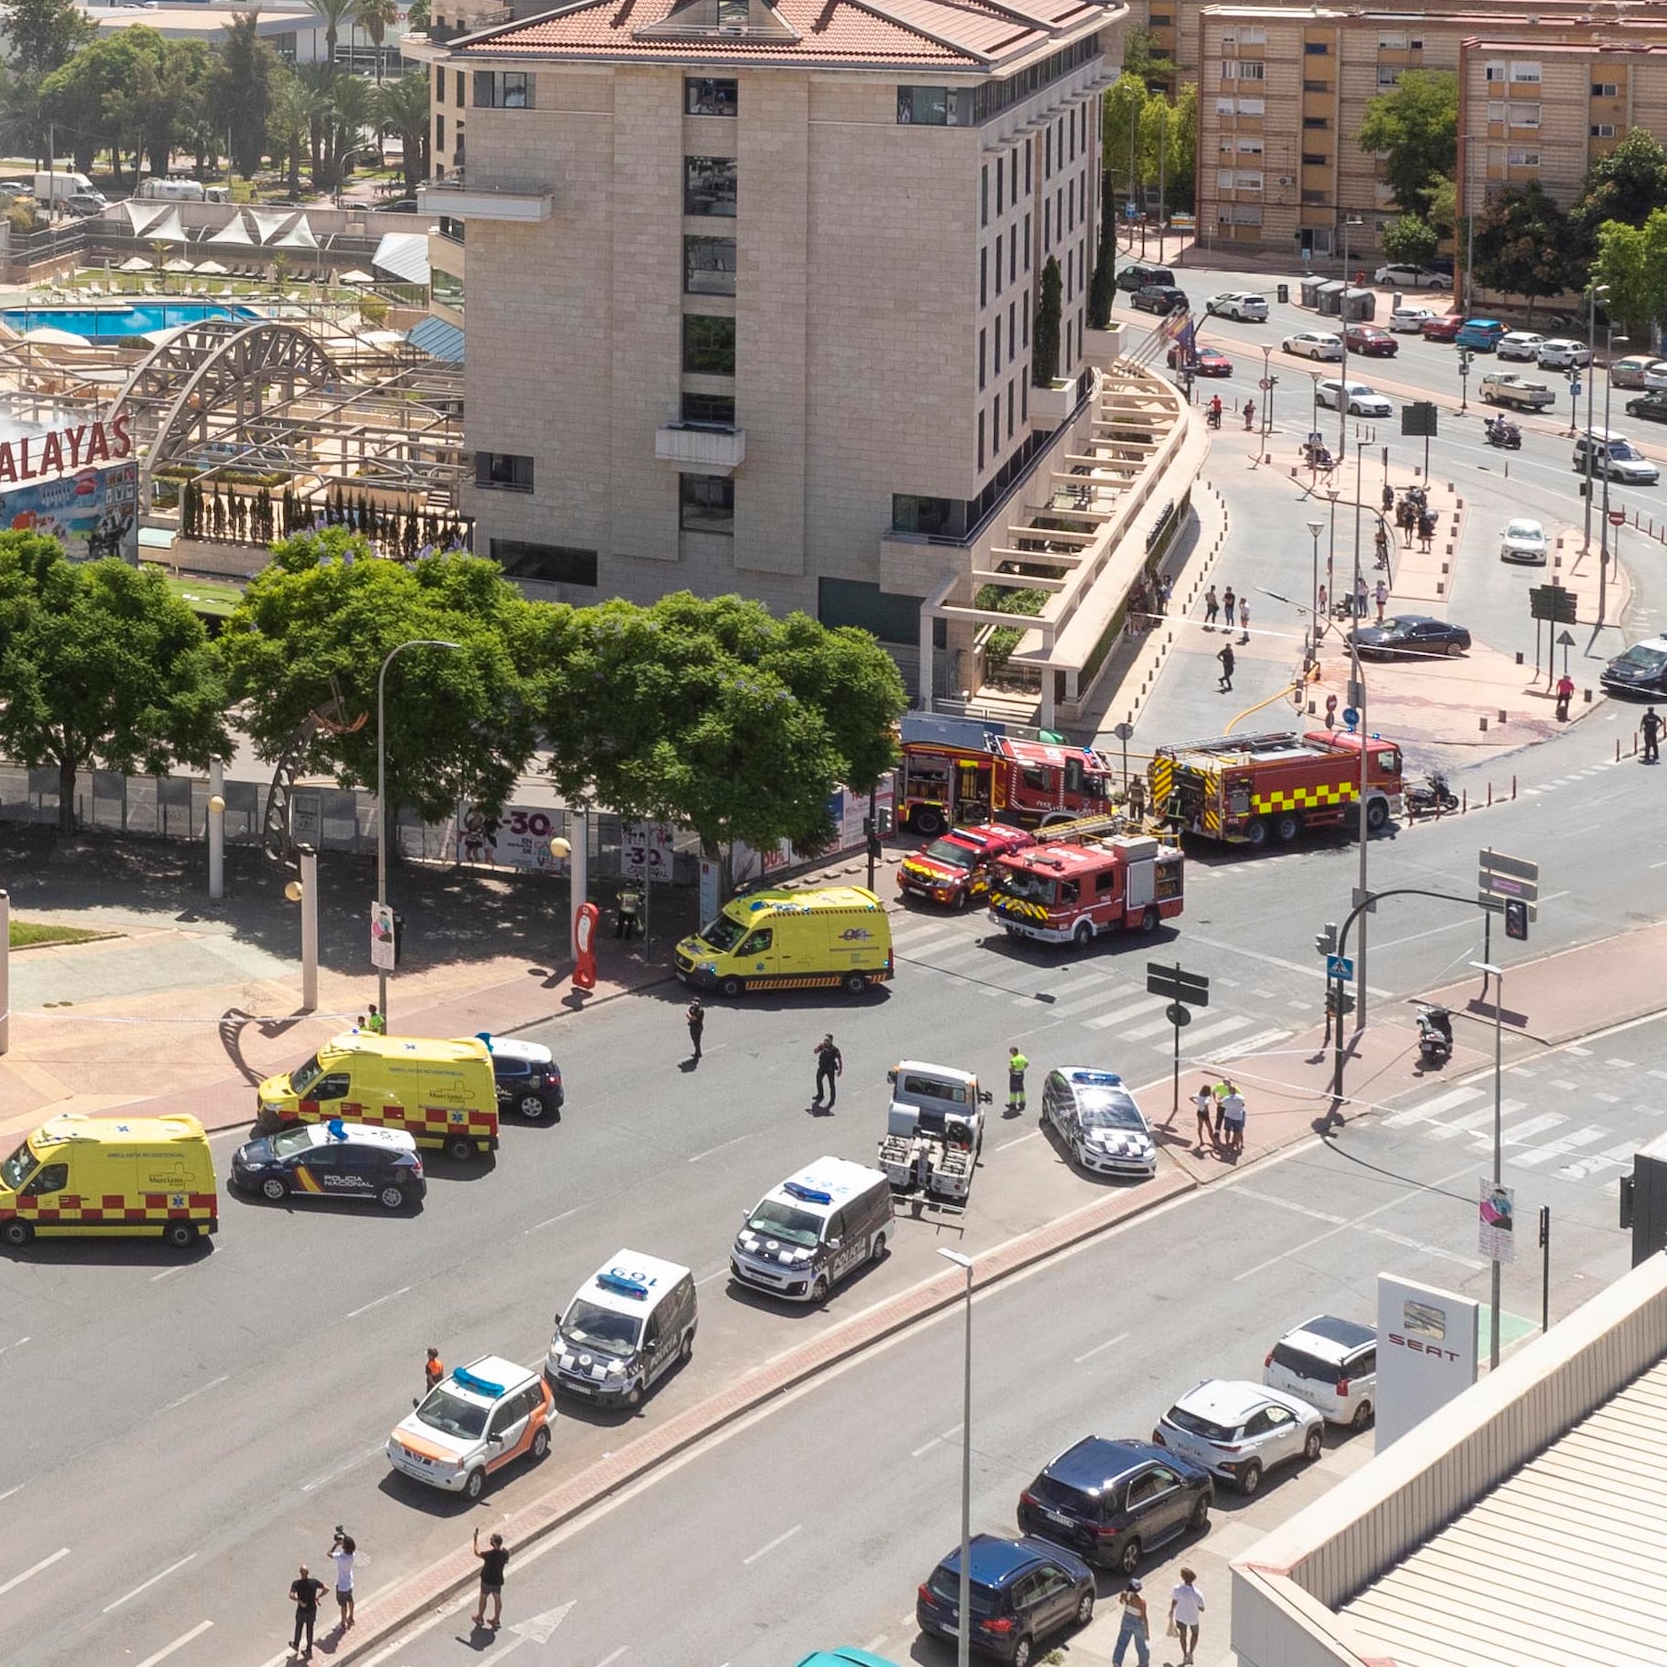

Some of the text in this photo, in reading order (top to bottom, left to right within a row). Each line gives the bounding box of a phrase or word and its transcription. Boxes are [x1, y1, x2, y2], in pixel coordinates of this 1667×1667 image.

[323, 1179, 375, 1189] NACIONAL
[324, 1175, 363, 1183] POLICIA
[1388, 1333, 1460, 1363] SEAT
